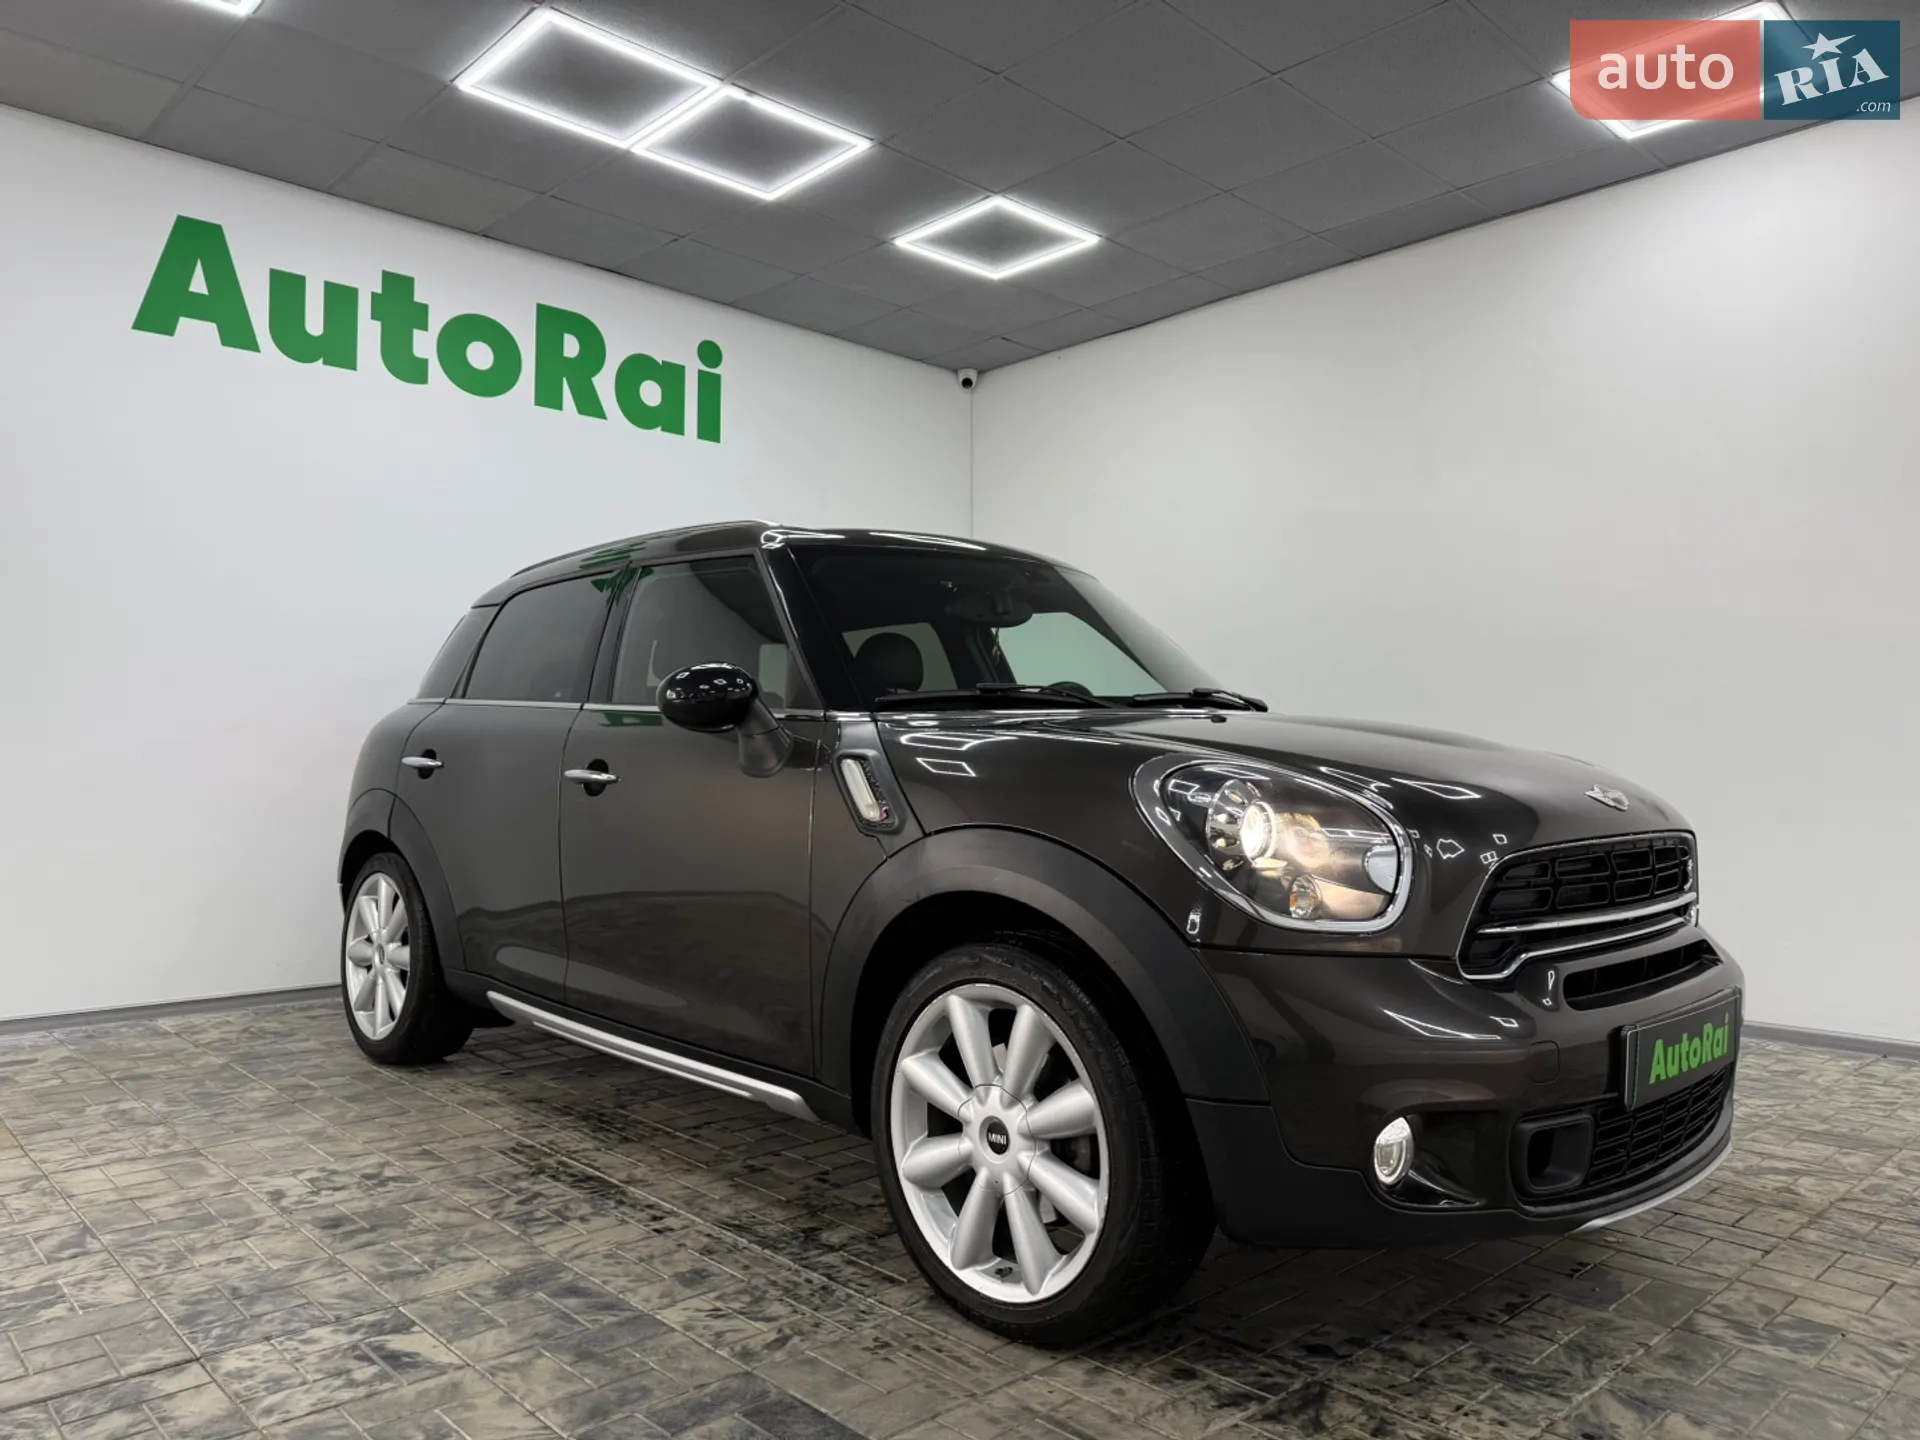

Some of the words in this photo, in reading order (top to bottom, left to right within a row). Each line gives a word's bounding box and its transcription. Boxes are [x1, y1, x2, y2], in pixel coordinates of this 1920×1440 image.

[131, 214, 723, 444] AutoRai
[1649, 1012, 1729, 1085] AutoRai
[988, 1132, 1007, 1145] MINI
